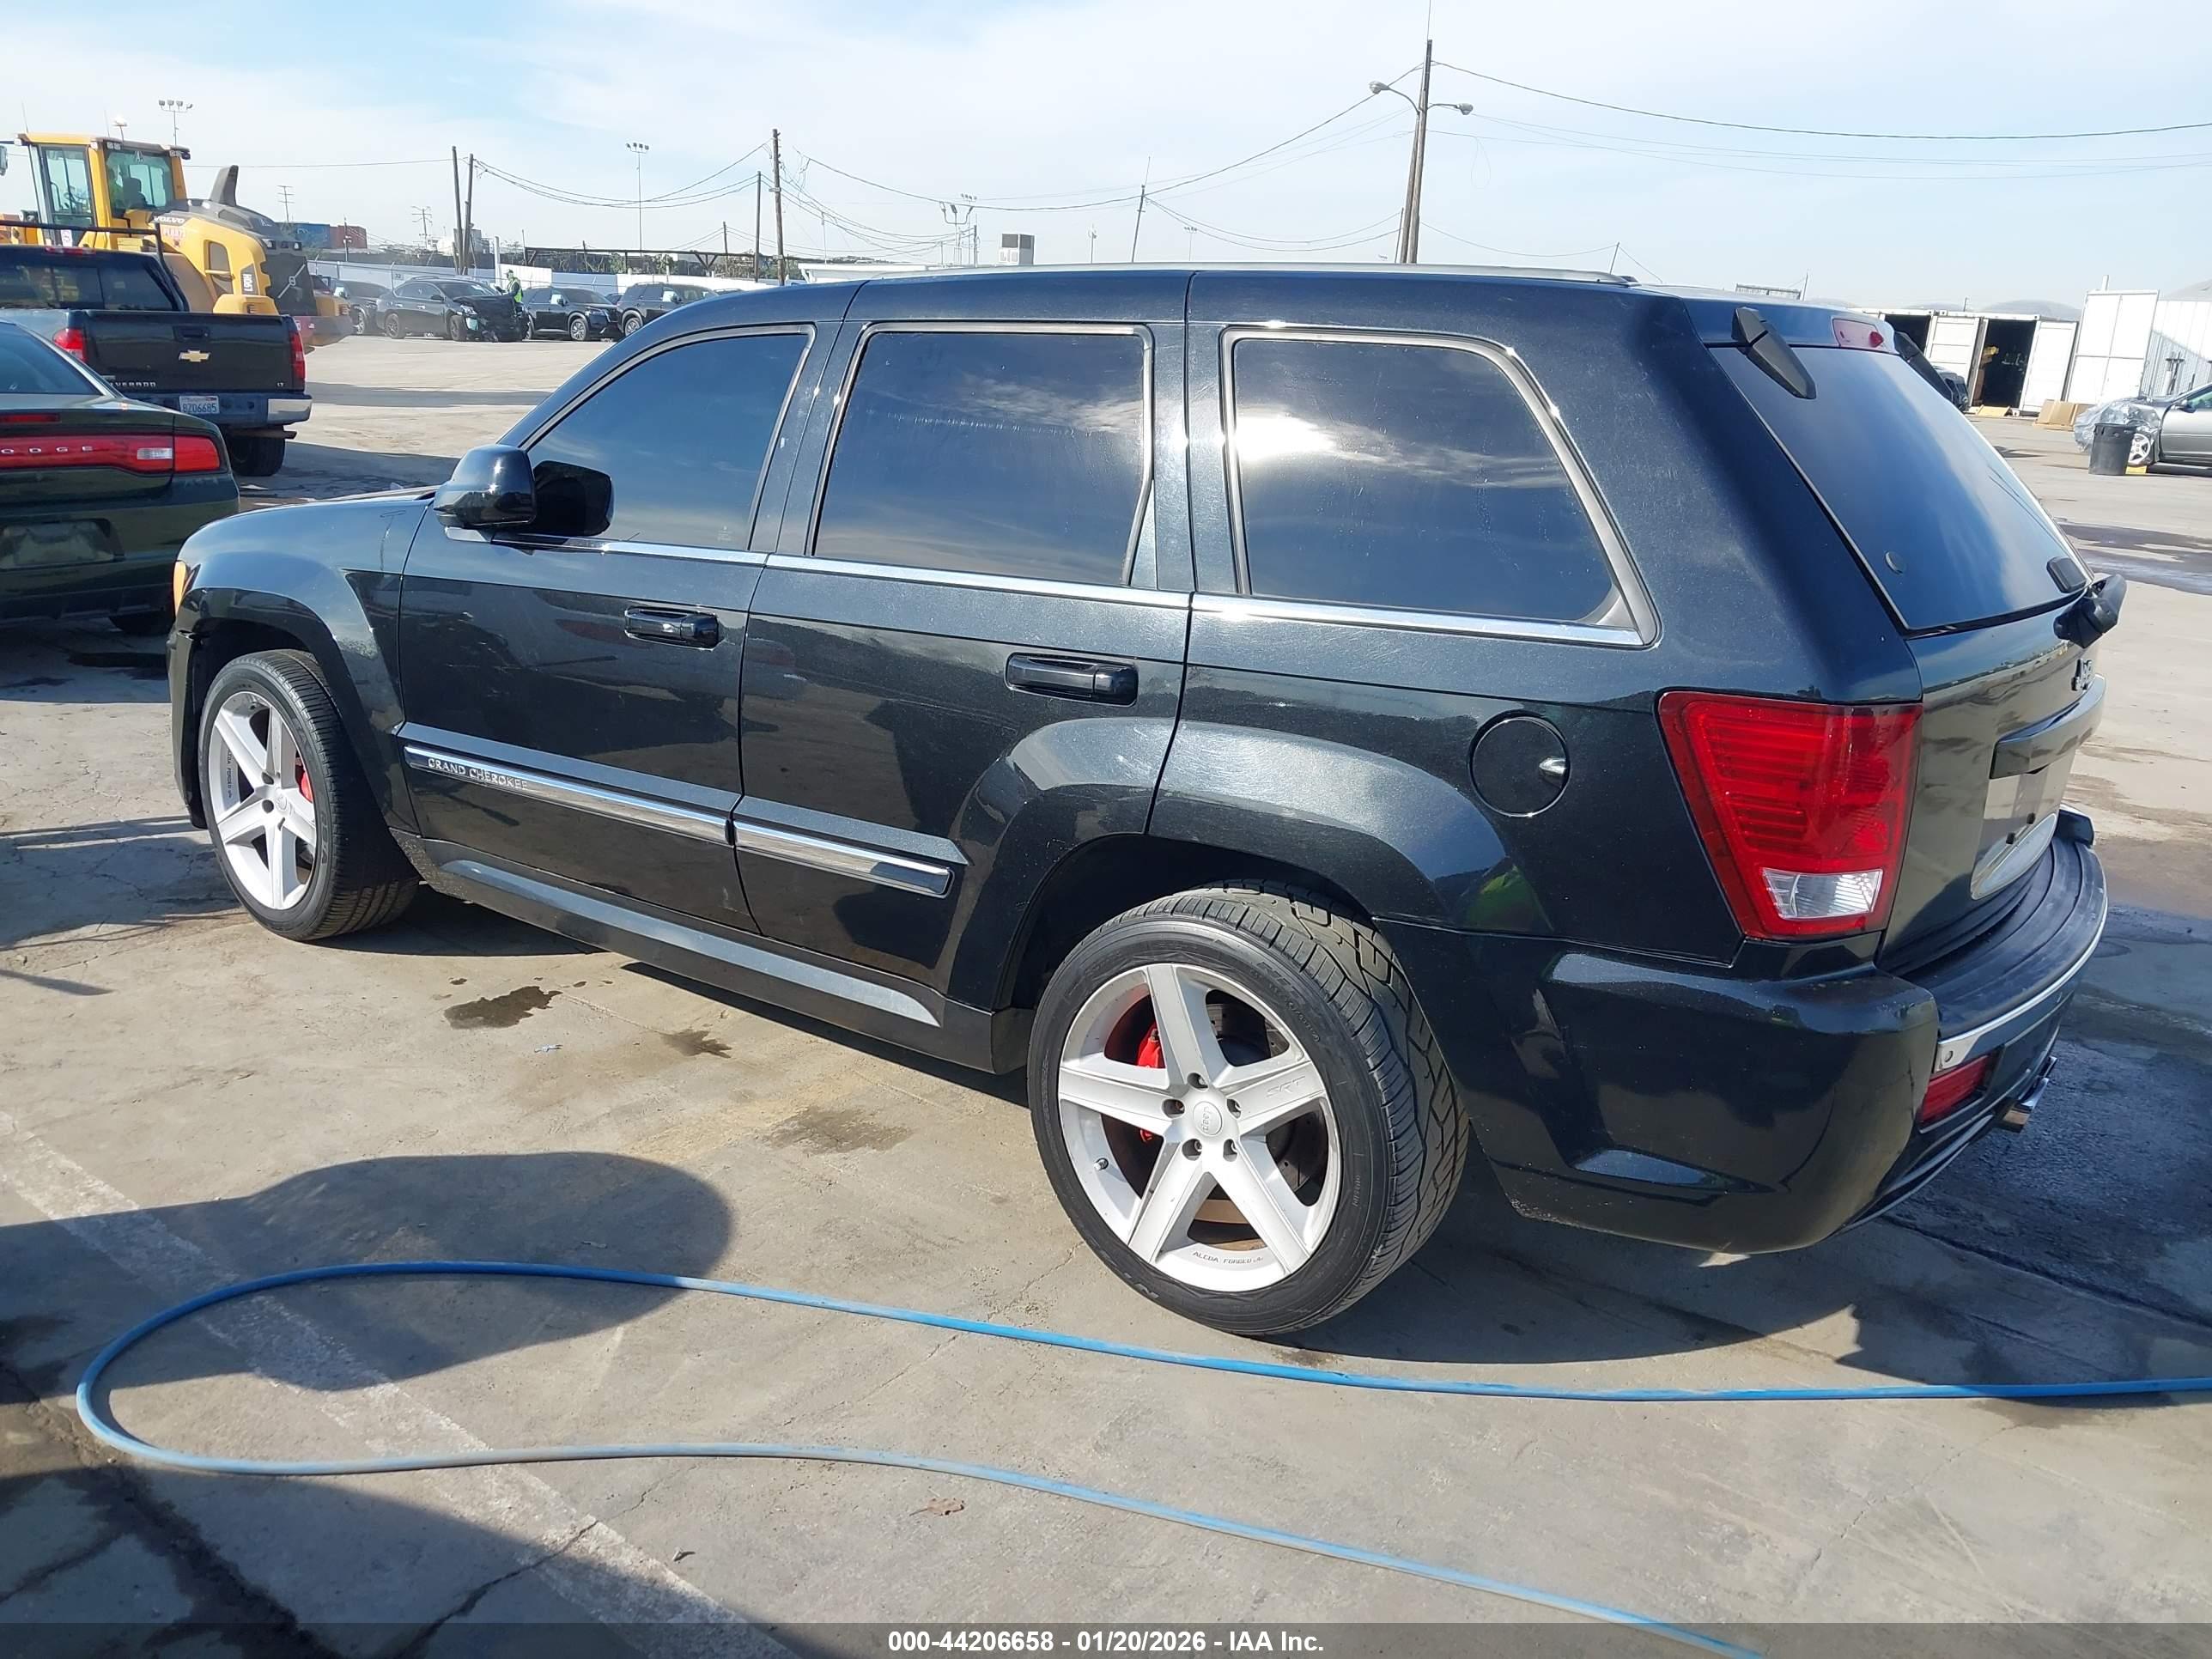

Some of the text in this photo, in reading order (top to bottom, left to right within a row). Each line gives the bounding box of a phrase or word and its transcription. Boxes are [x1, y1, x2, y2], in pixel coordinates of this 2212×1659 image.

[242, 274, 253, 291] L90H
[1, 446, 94, 454] ODGE
[428, 758, 527, 789] GRAND CHEROKEE
[1266, 1076, 1306, 1098] SRT
[1201, 1106, 1212, 1134] Jeep
[1192, 1251, 1218, 1262] ALCOA
